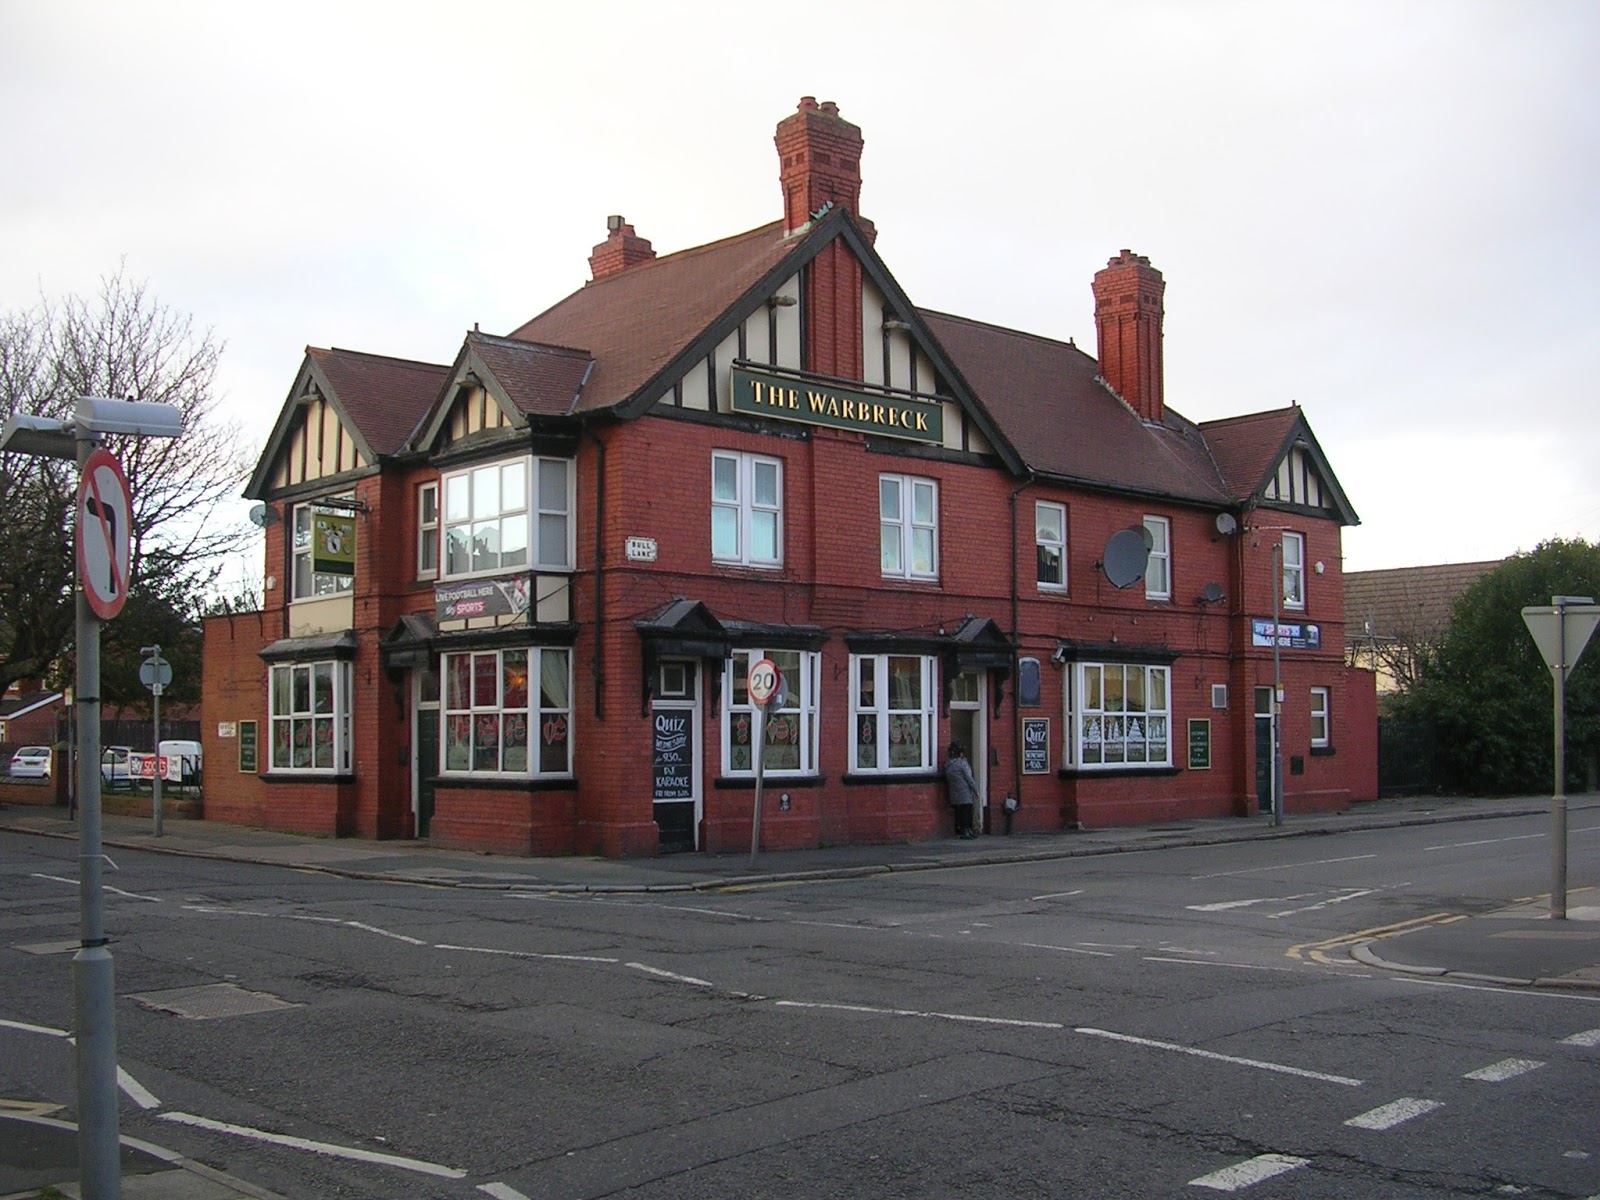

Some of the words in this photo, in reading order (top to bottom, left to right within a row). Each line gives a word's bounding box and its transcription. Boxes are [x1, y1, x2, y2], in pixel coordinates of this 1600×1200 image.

[750, 379, 800, 411] THE
[807, 390, 929, 432] WARBRECK
[632, 541, 650, 549] BULL
[456, 602, 483, 615] SPORTS
[1265, 624, 1291, 637] SPRTS
[752, 673, 775, 691] 20
[143, 758, 168, 774] spots
[663, 767, 675, 775] DJ
[655, 777, 689, 787] KARAOKE
